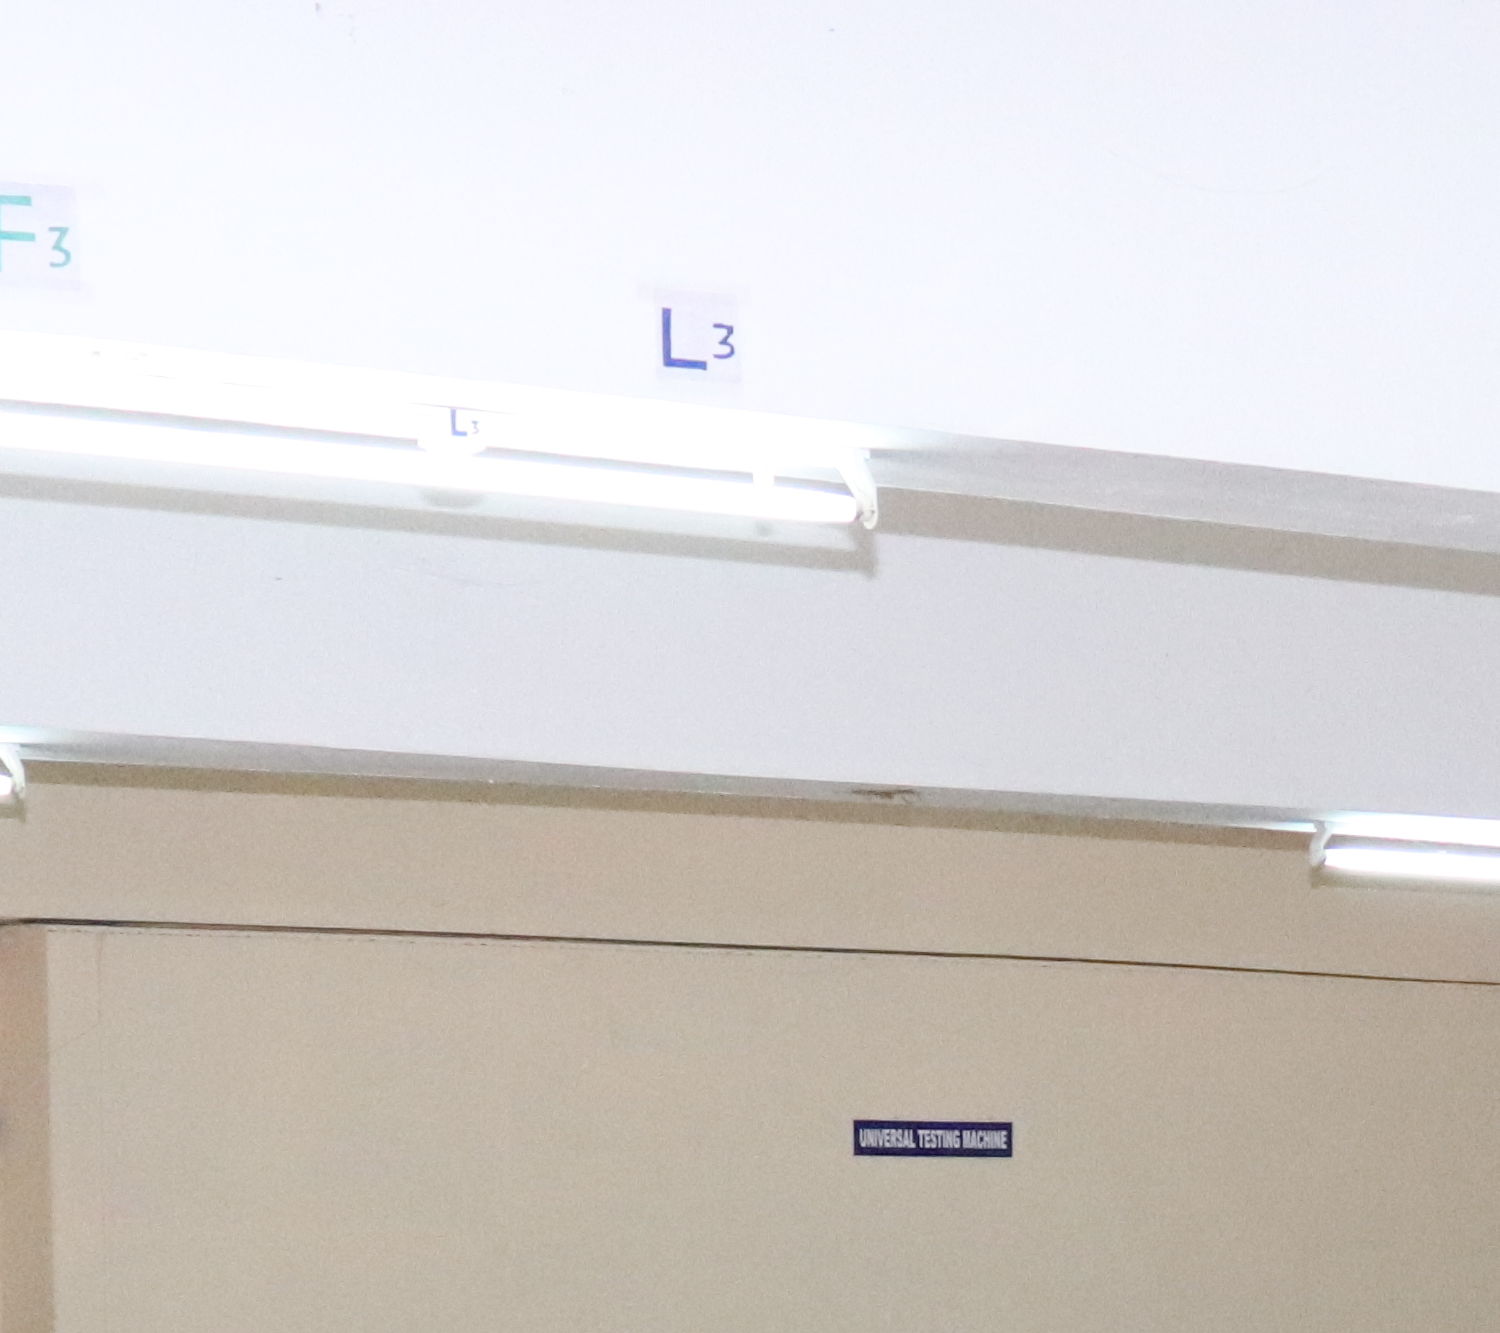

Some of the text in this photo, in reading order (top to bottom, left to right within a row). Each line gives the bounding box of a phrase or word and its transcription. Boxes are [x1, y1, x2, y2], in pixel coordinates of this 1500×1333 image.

[661, 307, 735, 371] L3
[859, 1128, 1008, 1149] UNIVERSAL TESTING MACHINE
